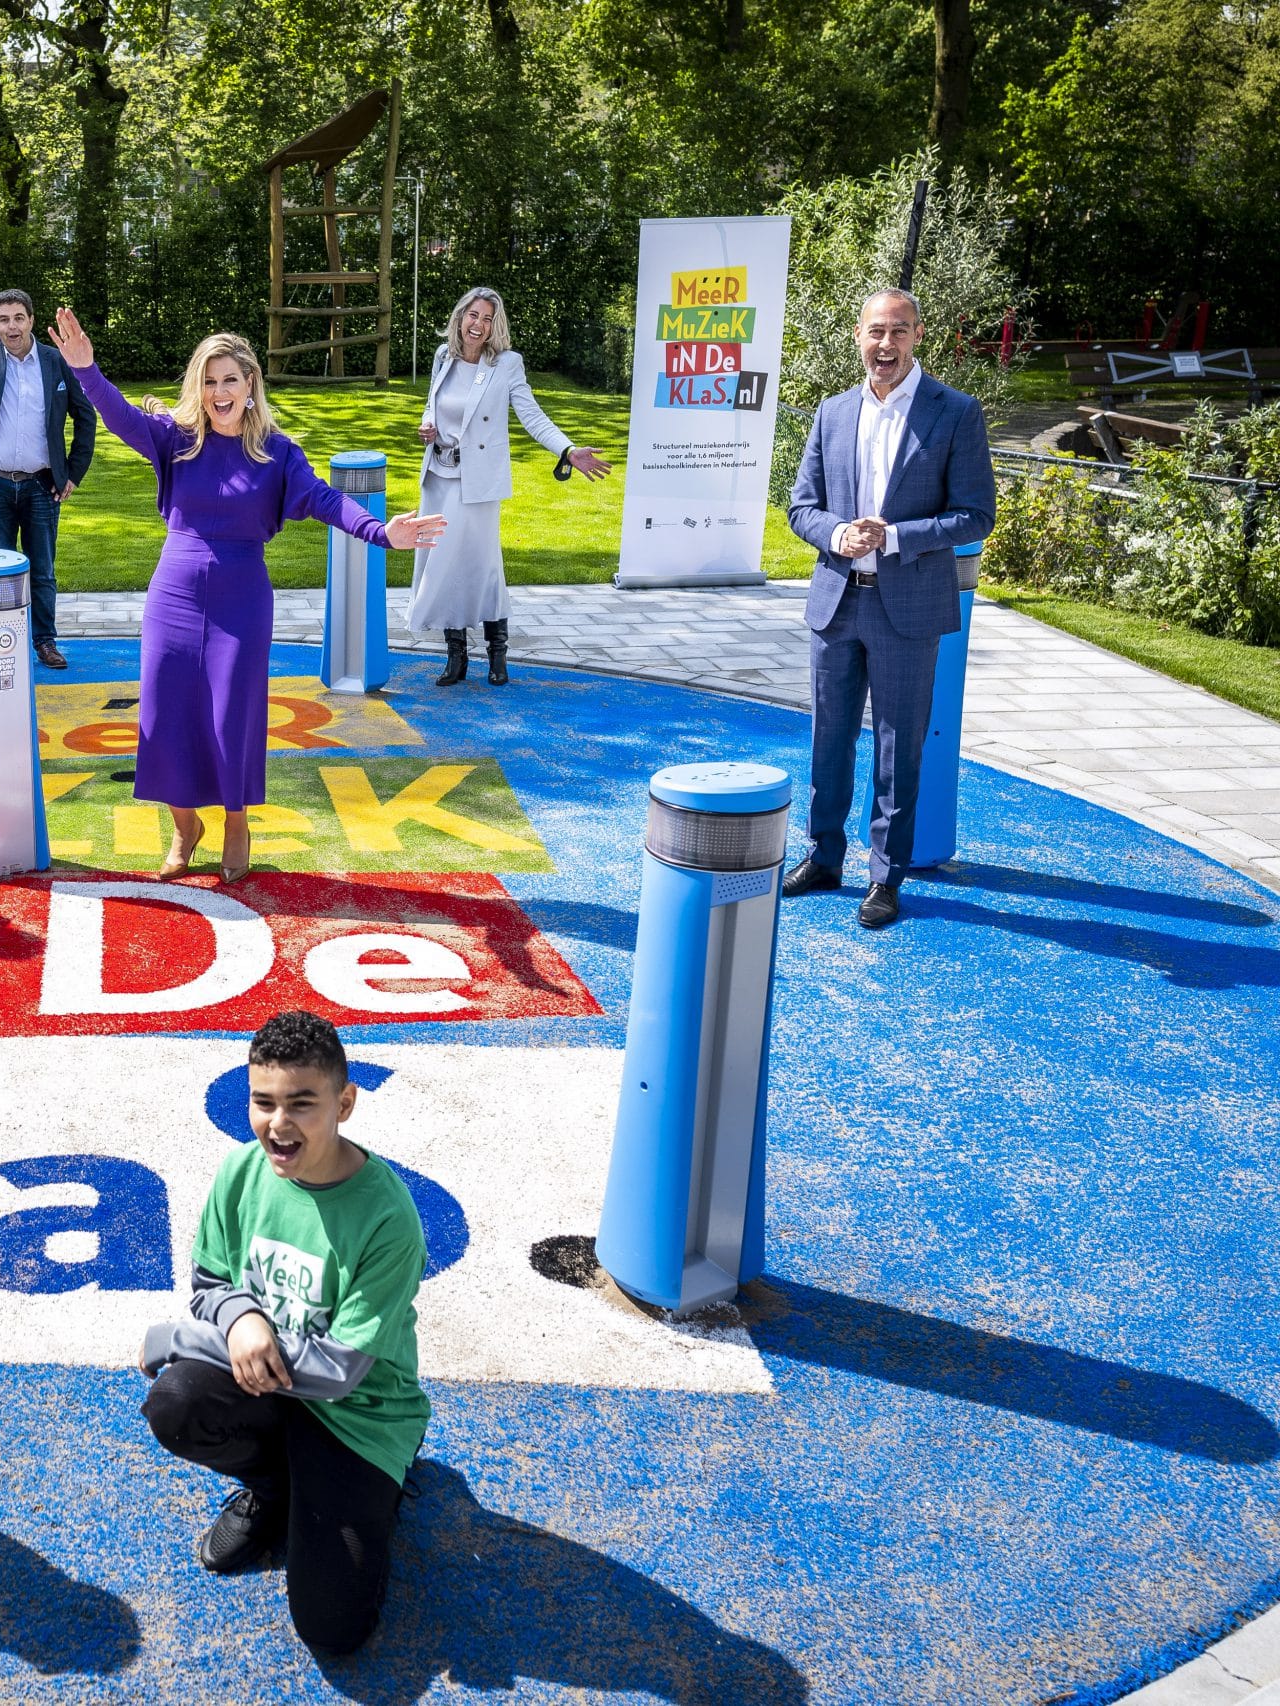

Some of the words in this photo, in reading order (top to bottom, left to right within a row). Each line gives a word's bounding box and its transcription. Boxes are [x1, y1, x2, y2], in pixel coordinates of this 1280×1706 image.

[663, 310, 748, 340] MuZieK
[672, 344, 697, 373] iN
[705, 344, 736, 372] De
[652, 442, 692, 450] Structureel
[693, 441, 750, 450] muziekonderwijs
[642, 462, 712, 470] basisschoolkinderen
[721, 460, 757, 468] Nederland
[708, 451, 734, 460] miljoen
[38, 881, 472, 1015] De
